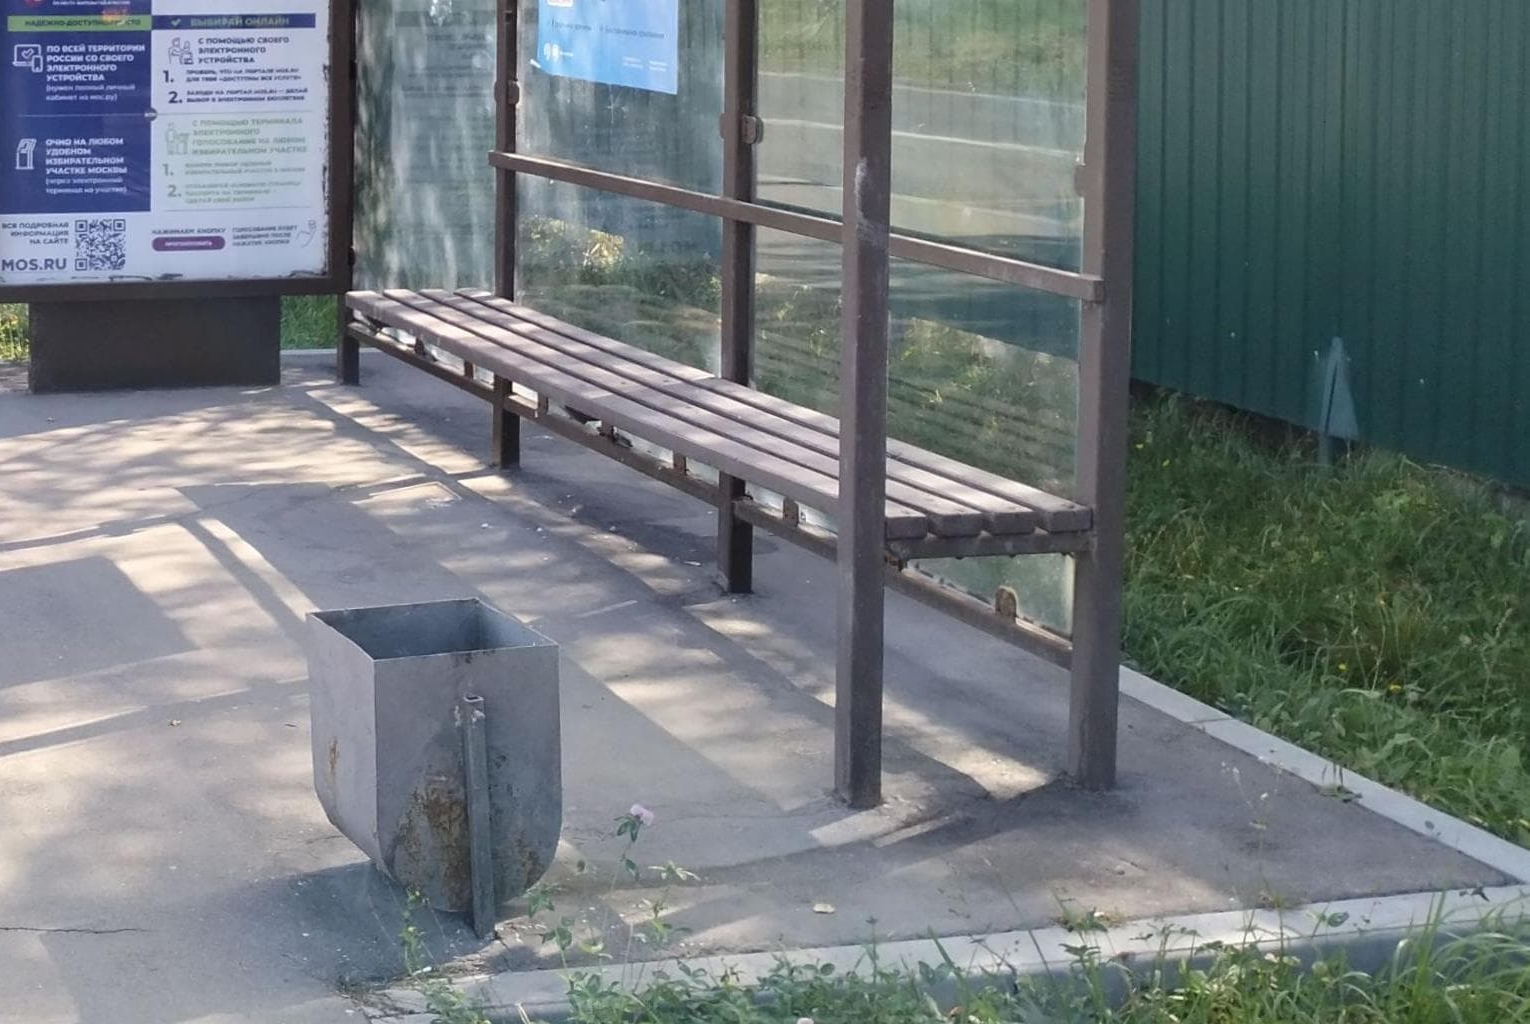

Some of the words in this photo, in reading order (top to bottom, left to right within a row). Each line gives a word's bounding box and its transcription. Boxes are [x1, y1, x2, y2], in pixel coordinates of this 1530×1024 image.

[191, 16, 243, 26] ВЫБИРАЙ
[245, 16, 290, 25] ОНЛАЙН
[206, 37, 254, 45] ПОМОЩЬЮ
[62, 44, 85, 52] ВСЕЙ
[88, 44, 145, 52] ТЕРРИТОРИИ
[198, 46, 266, 54] ЭЛЕКТРОННОГО
[99, 54, 134, 62] СВОЕГО
[198, 55, 255, 64] УСТРОЙСТВА
[46, 64, 117, 72] ЭЛЕКТРОННОГО
[46, 73, 105, 81] УСТРОЙСТВА
[163, 70, 174, 83] 1.
[168, 91, 183, 104] 2.
[46, 148, 91, 156] УДОБНОМ
[46, 157, 124, 165] ИЗБИРАТЕЛЬНОМ
[46, 167, 86, 175] УЧАСТКЕ
[1, 258, 67, 271] MOS.RU
